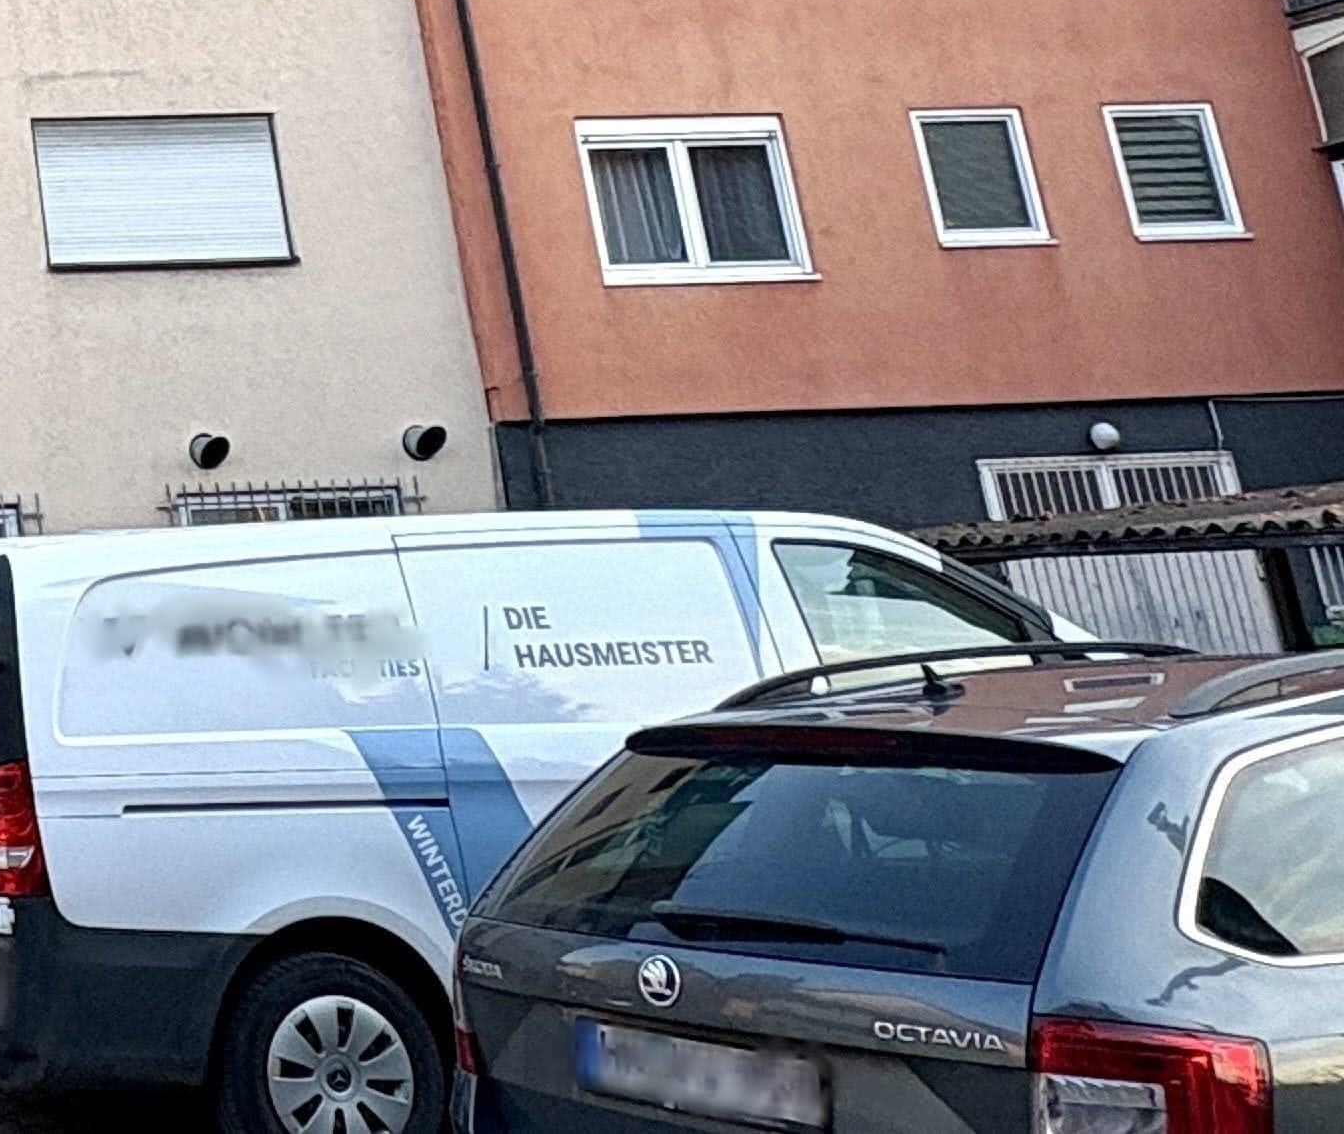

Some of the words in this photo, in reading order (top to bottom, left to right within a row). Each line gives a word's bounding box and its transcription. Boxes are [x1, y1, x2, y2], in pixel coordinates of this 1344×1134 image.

[503, 606, 552, 630] DIE
[514, 640, 714, 668] HAUSMEISTER
[407, 814, 469, 930] WINTERD
[873, 1021, 1006, 1052] OCTAVIA
